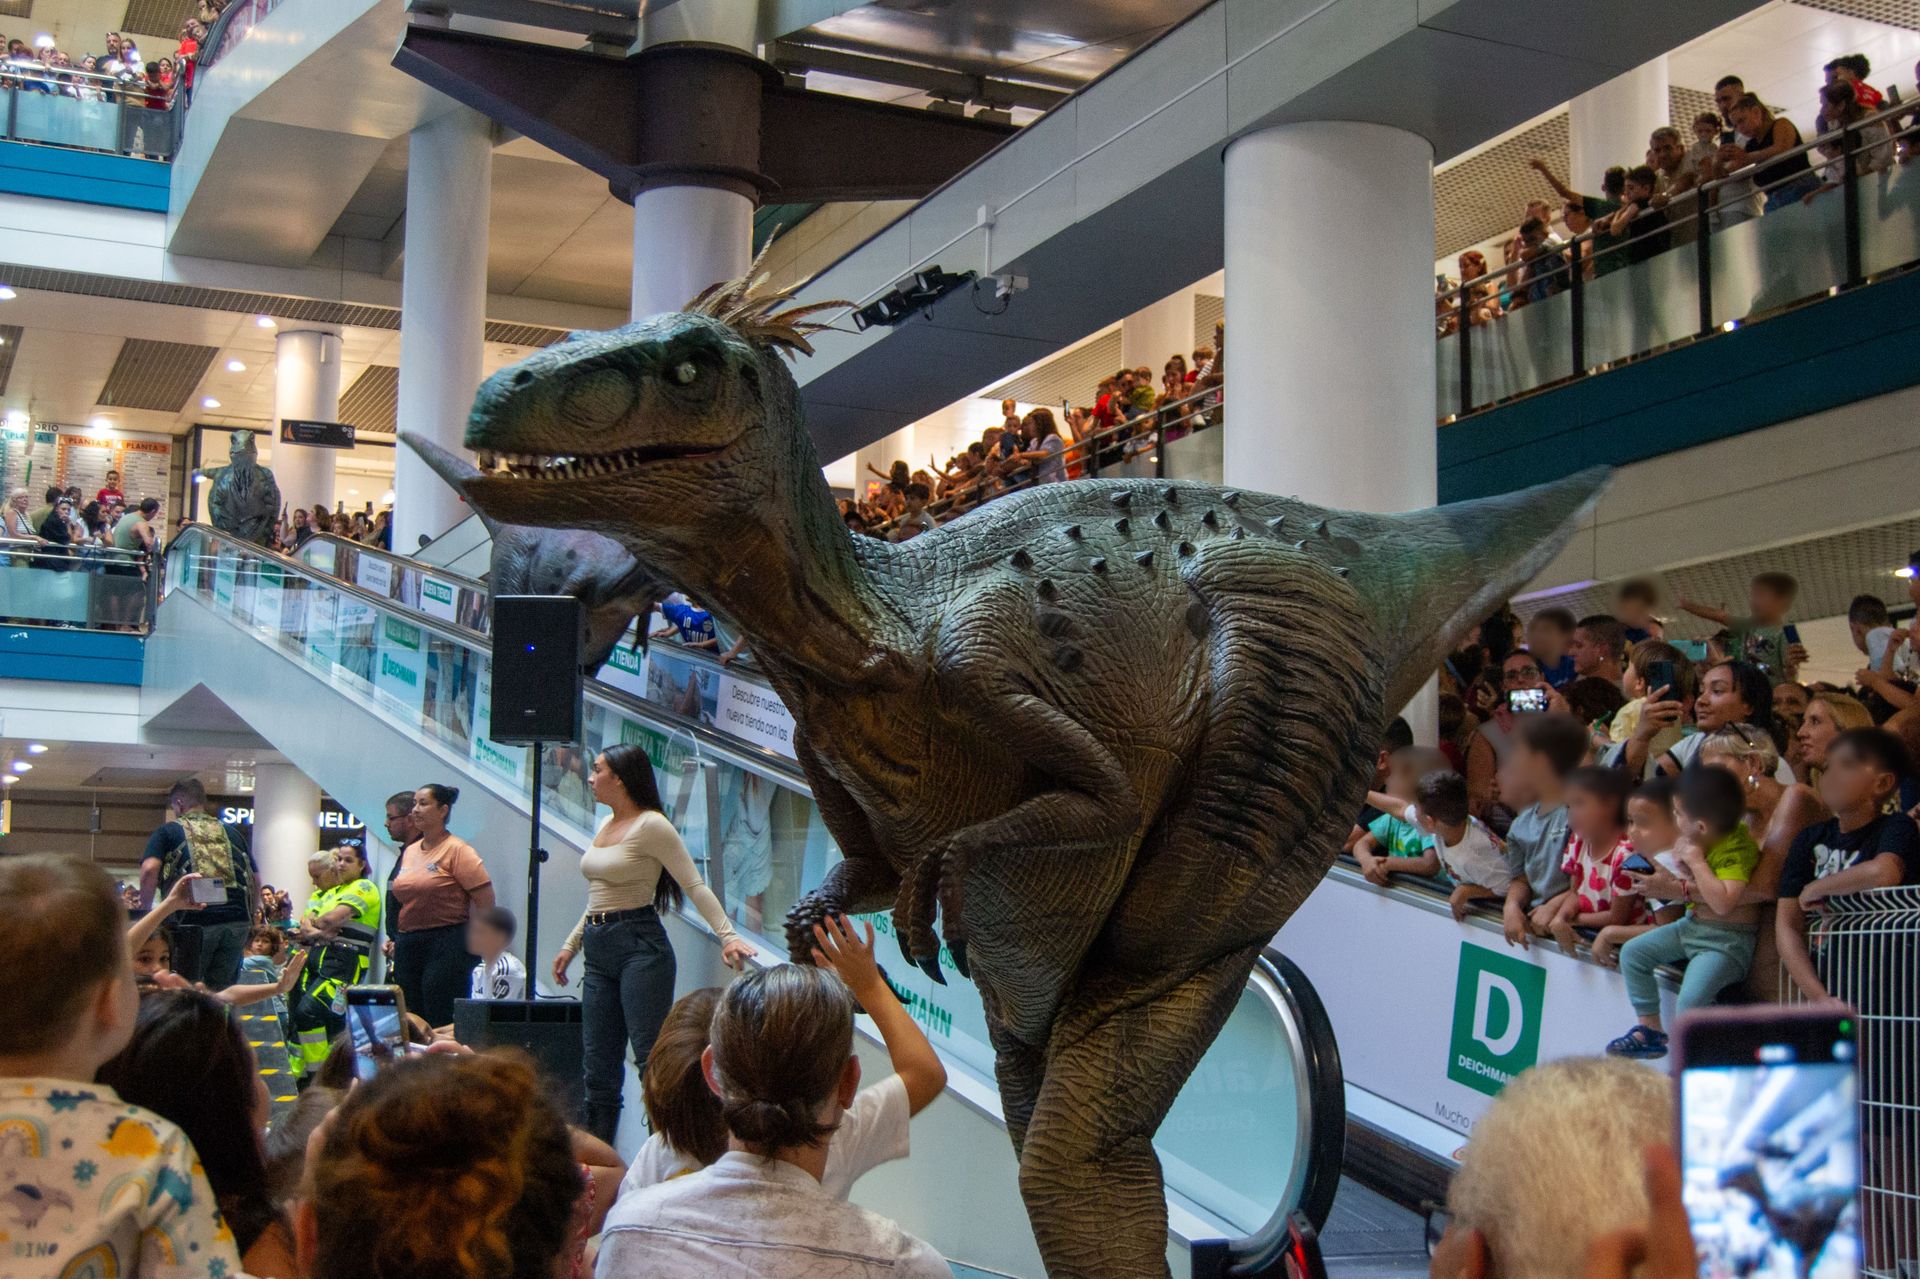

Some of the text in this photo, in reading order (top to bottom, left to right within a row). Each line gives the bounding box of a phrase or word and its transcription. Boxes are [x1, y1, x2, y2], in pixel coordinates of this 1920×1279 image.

[68, 437, 102, 447] PLANTA
[126, 442, 157, 451] PLANTA
[615, 650, 639, 671] TIENDA
[732, 684, 786, 717] Descubre nuestra
[726, 708, 788, 741] nueva tienda con las
[1471, 969, 1524, 1057] D
[1435, 1101, 1470, 1129] Mucho
